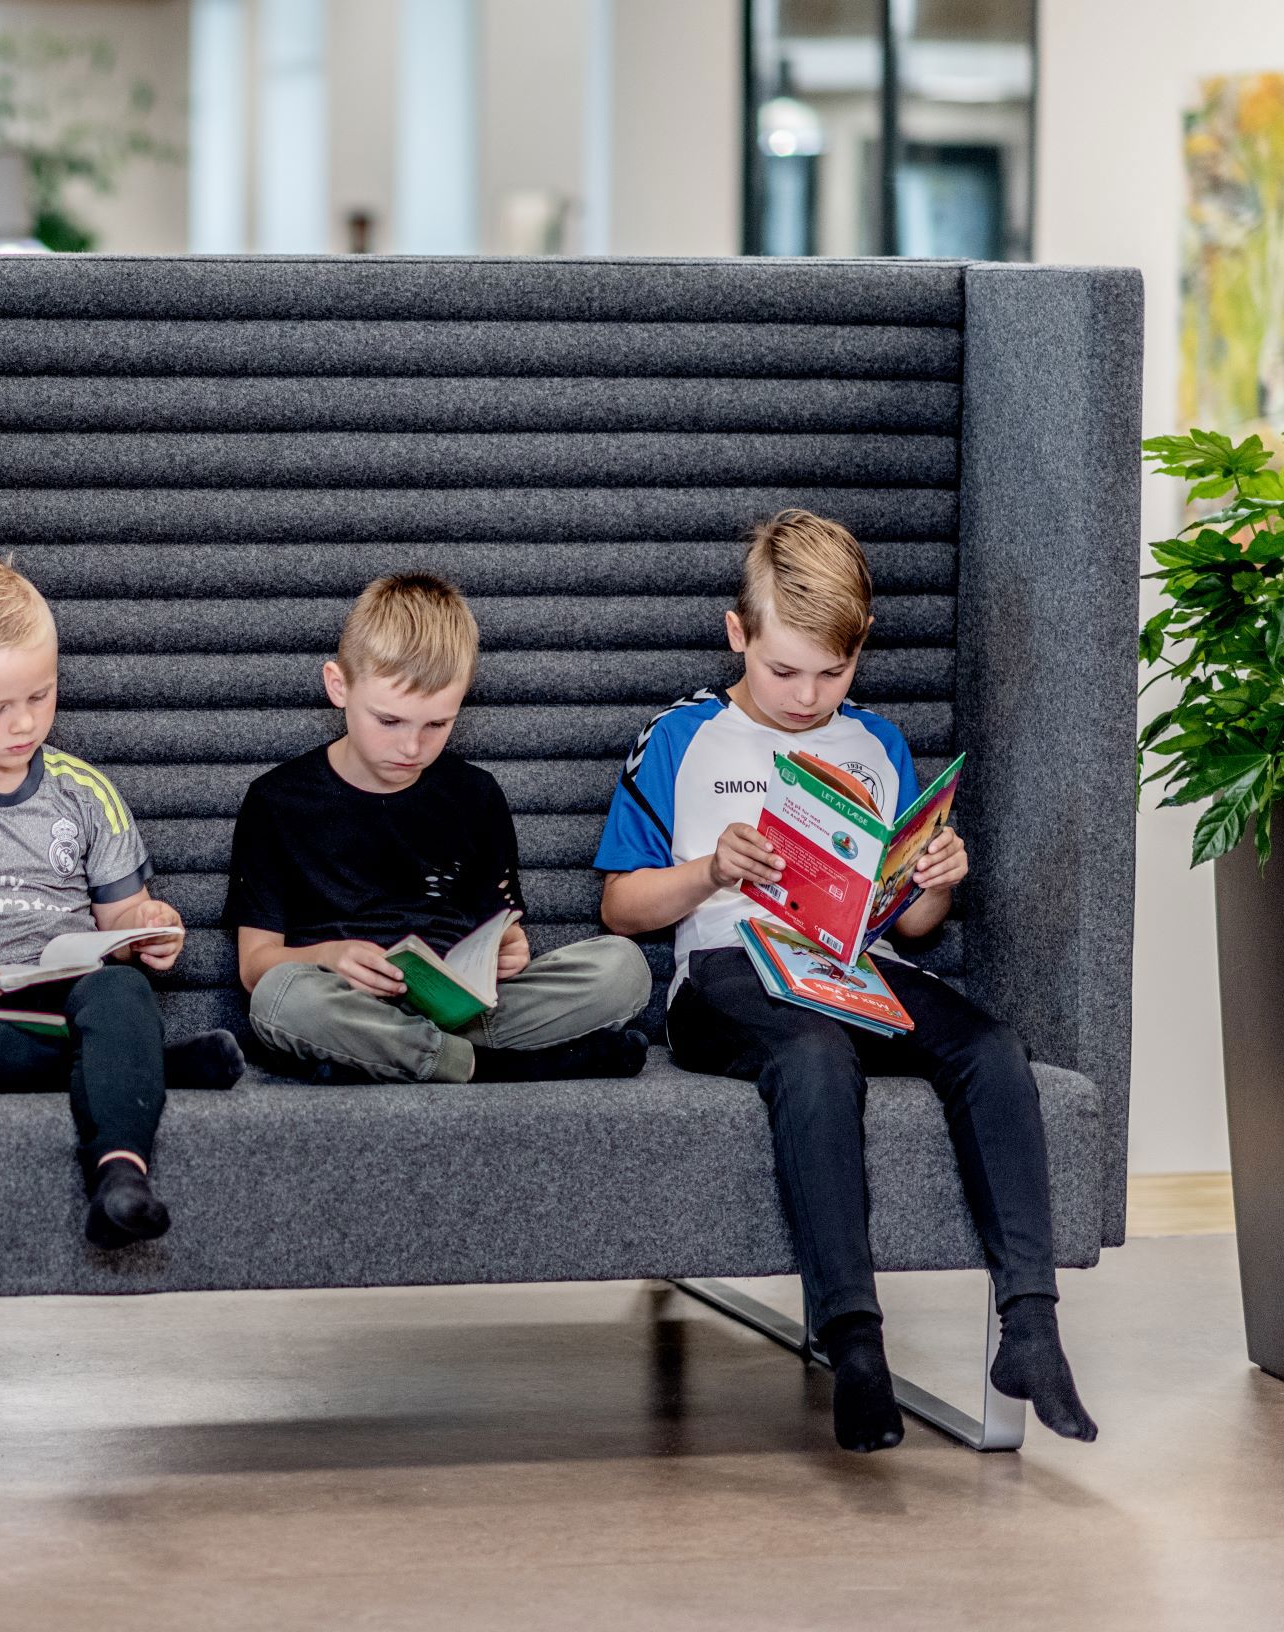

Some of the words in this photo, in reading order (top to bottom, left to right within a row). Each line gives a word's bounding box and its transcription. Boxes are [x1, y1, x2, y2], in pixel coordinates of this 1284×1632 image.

[847, 763, 863, 771] 1934
[714, 780, 768, 794] SIMON
[821, 790, 835, 802] LET
[836, 801, 846, 811] AT
[847, 808, 868, 826] LÆSE
